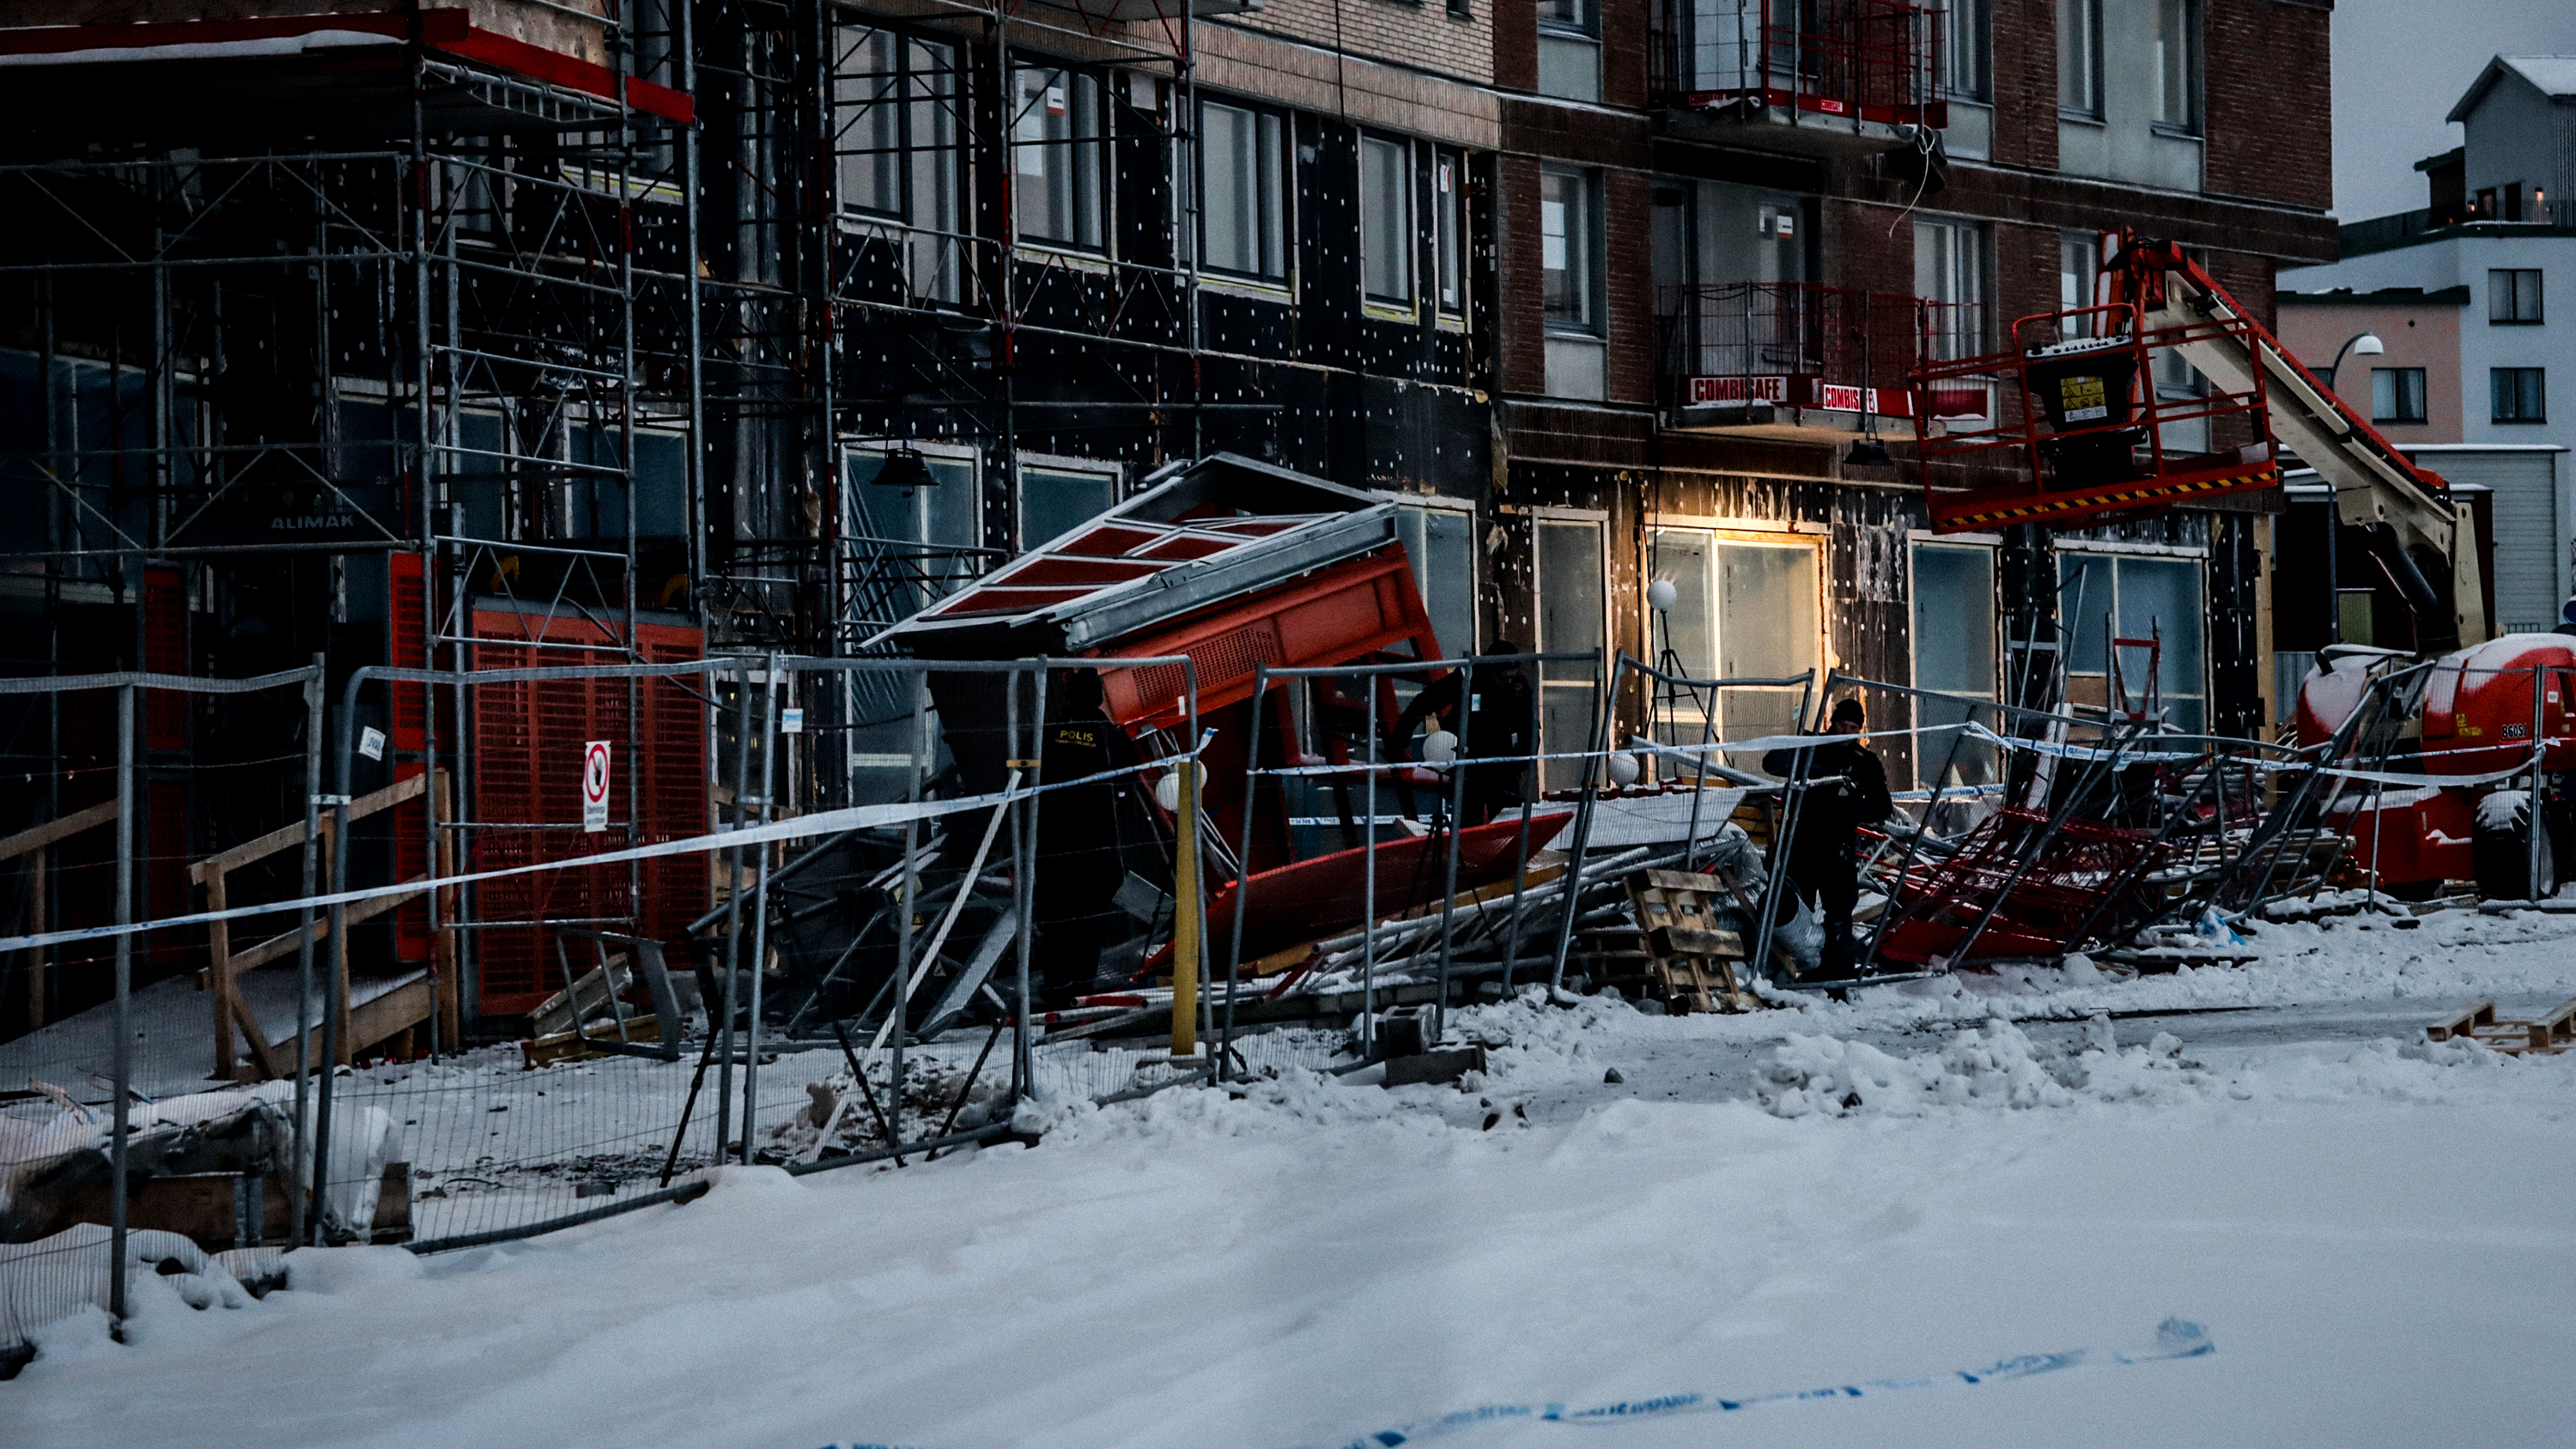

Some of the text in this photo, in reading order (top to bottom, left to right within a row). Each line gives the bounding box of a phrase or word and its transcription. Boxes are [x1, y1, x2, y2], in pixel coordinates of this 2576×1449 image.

[1826, 386, 1874, 410] COMBISE
[270, 514, 354, 529] ALIMAK
[1060, 730, 1093, 742] POLIS
[2501, 724, 2527, 738] 860SJ
